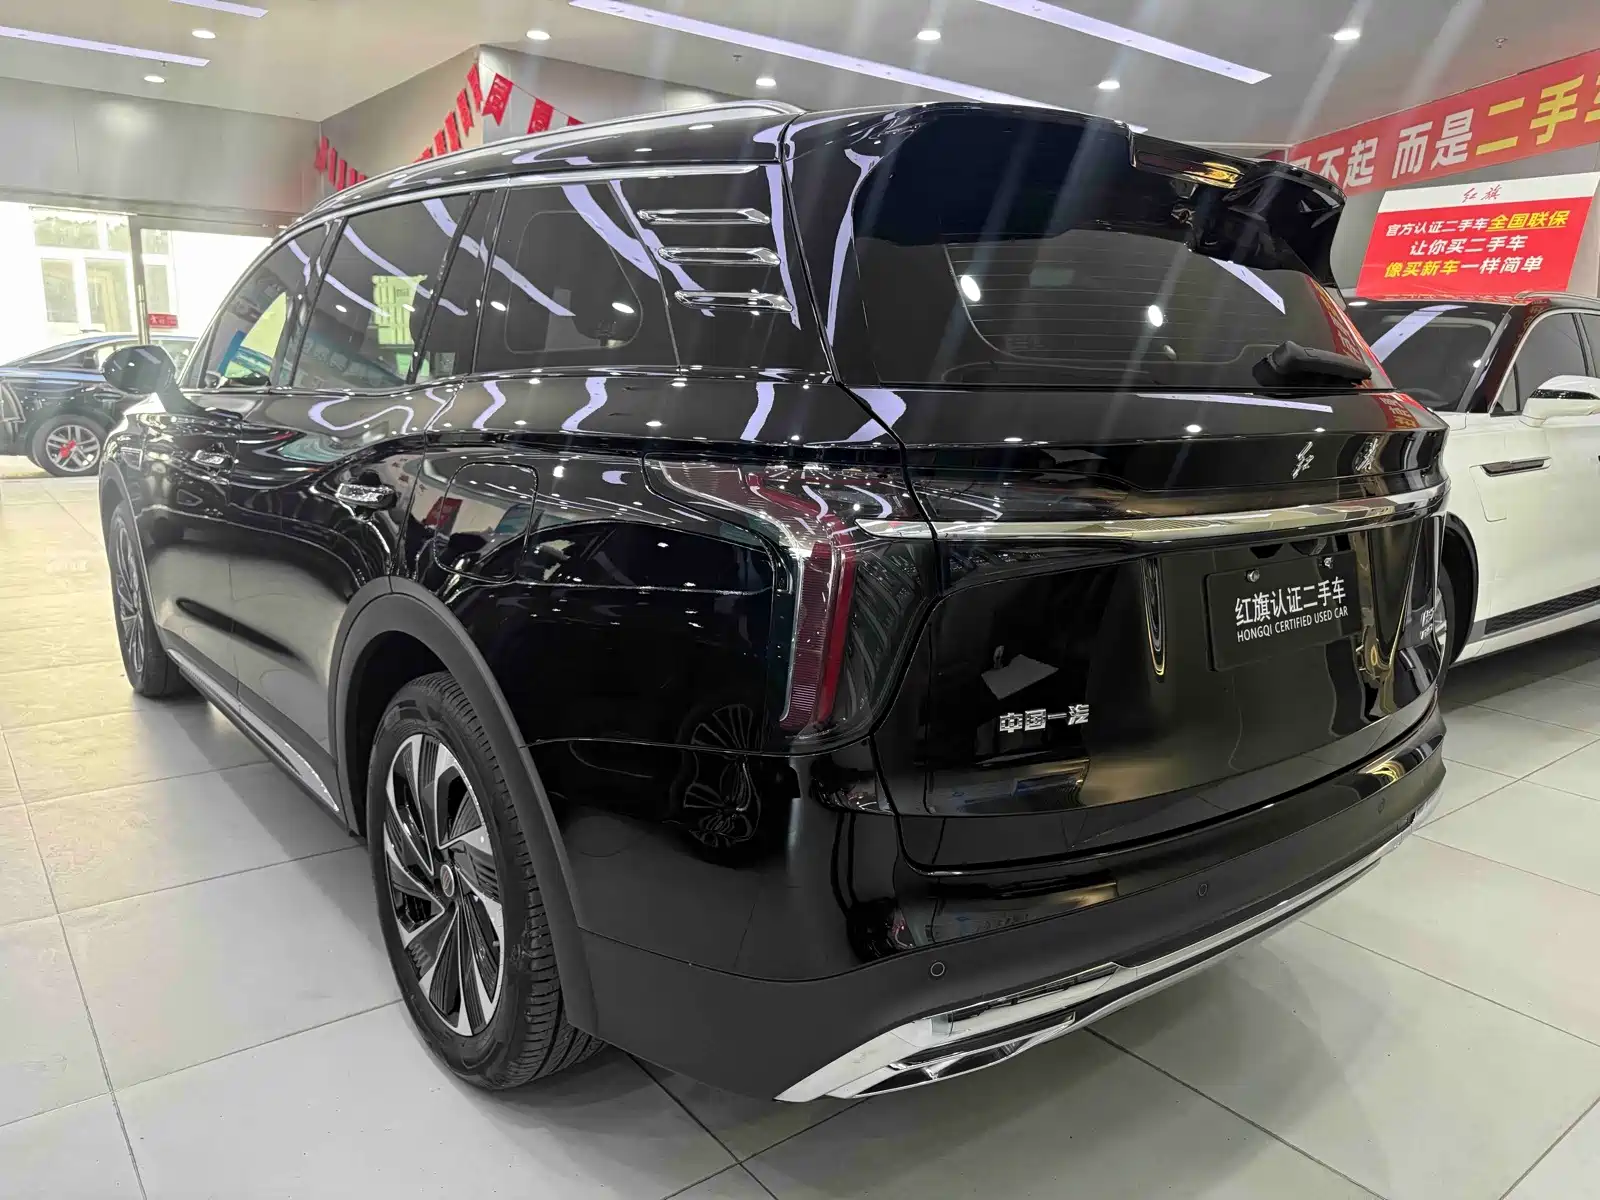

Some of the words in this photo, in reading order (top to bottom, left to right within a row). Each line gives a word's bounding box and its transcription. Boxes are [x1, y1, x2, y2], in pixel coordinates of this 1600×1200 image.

[1462, 184, 1502, 203] 红旗
[1385, 210, 1570, 237] 官方认证二手车全国联保
[1409, 235, 1528, 256] 让你买二手车
[1384, 255, 1544, 278] 像买新车一样简单
[1235, 576, 1346, 627] 红旗认证二手车
[1236, 623, 1273, 643] HONGQI
[1274, 614, 1312, 634] CERTIFIED
[1313, 609, 1333, 624] USED
[1333, 605, 1349, 619] CAR
[999, 704, 1090, 733] 中国一汽
